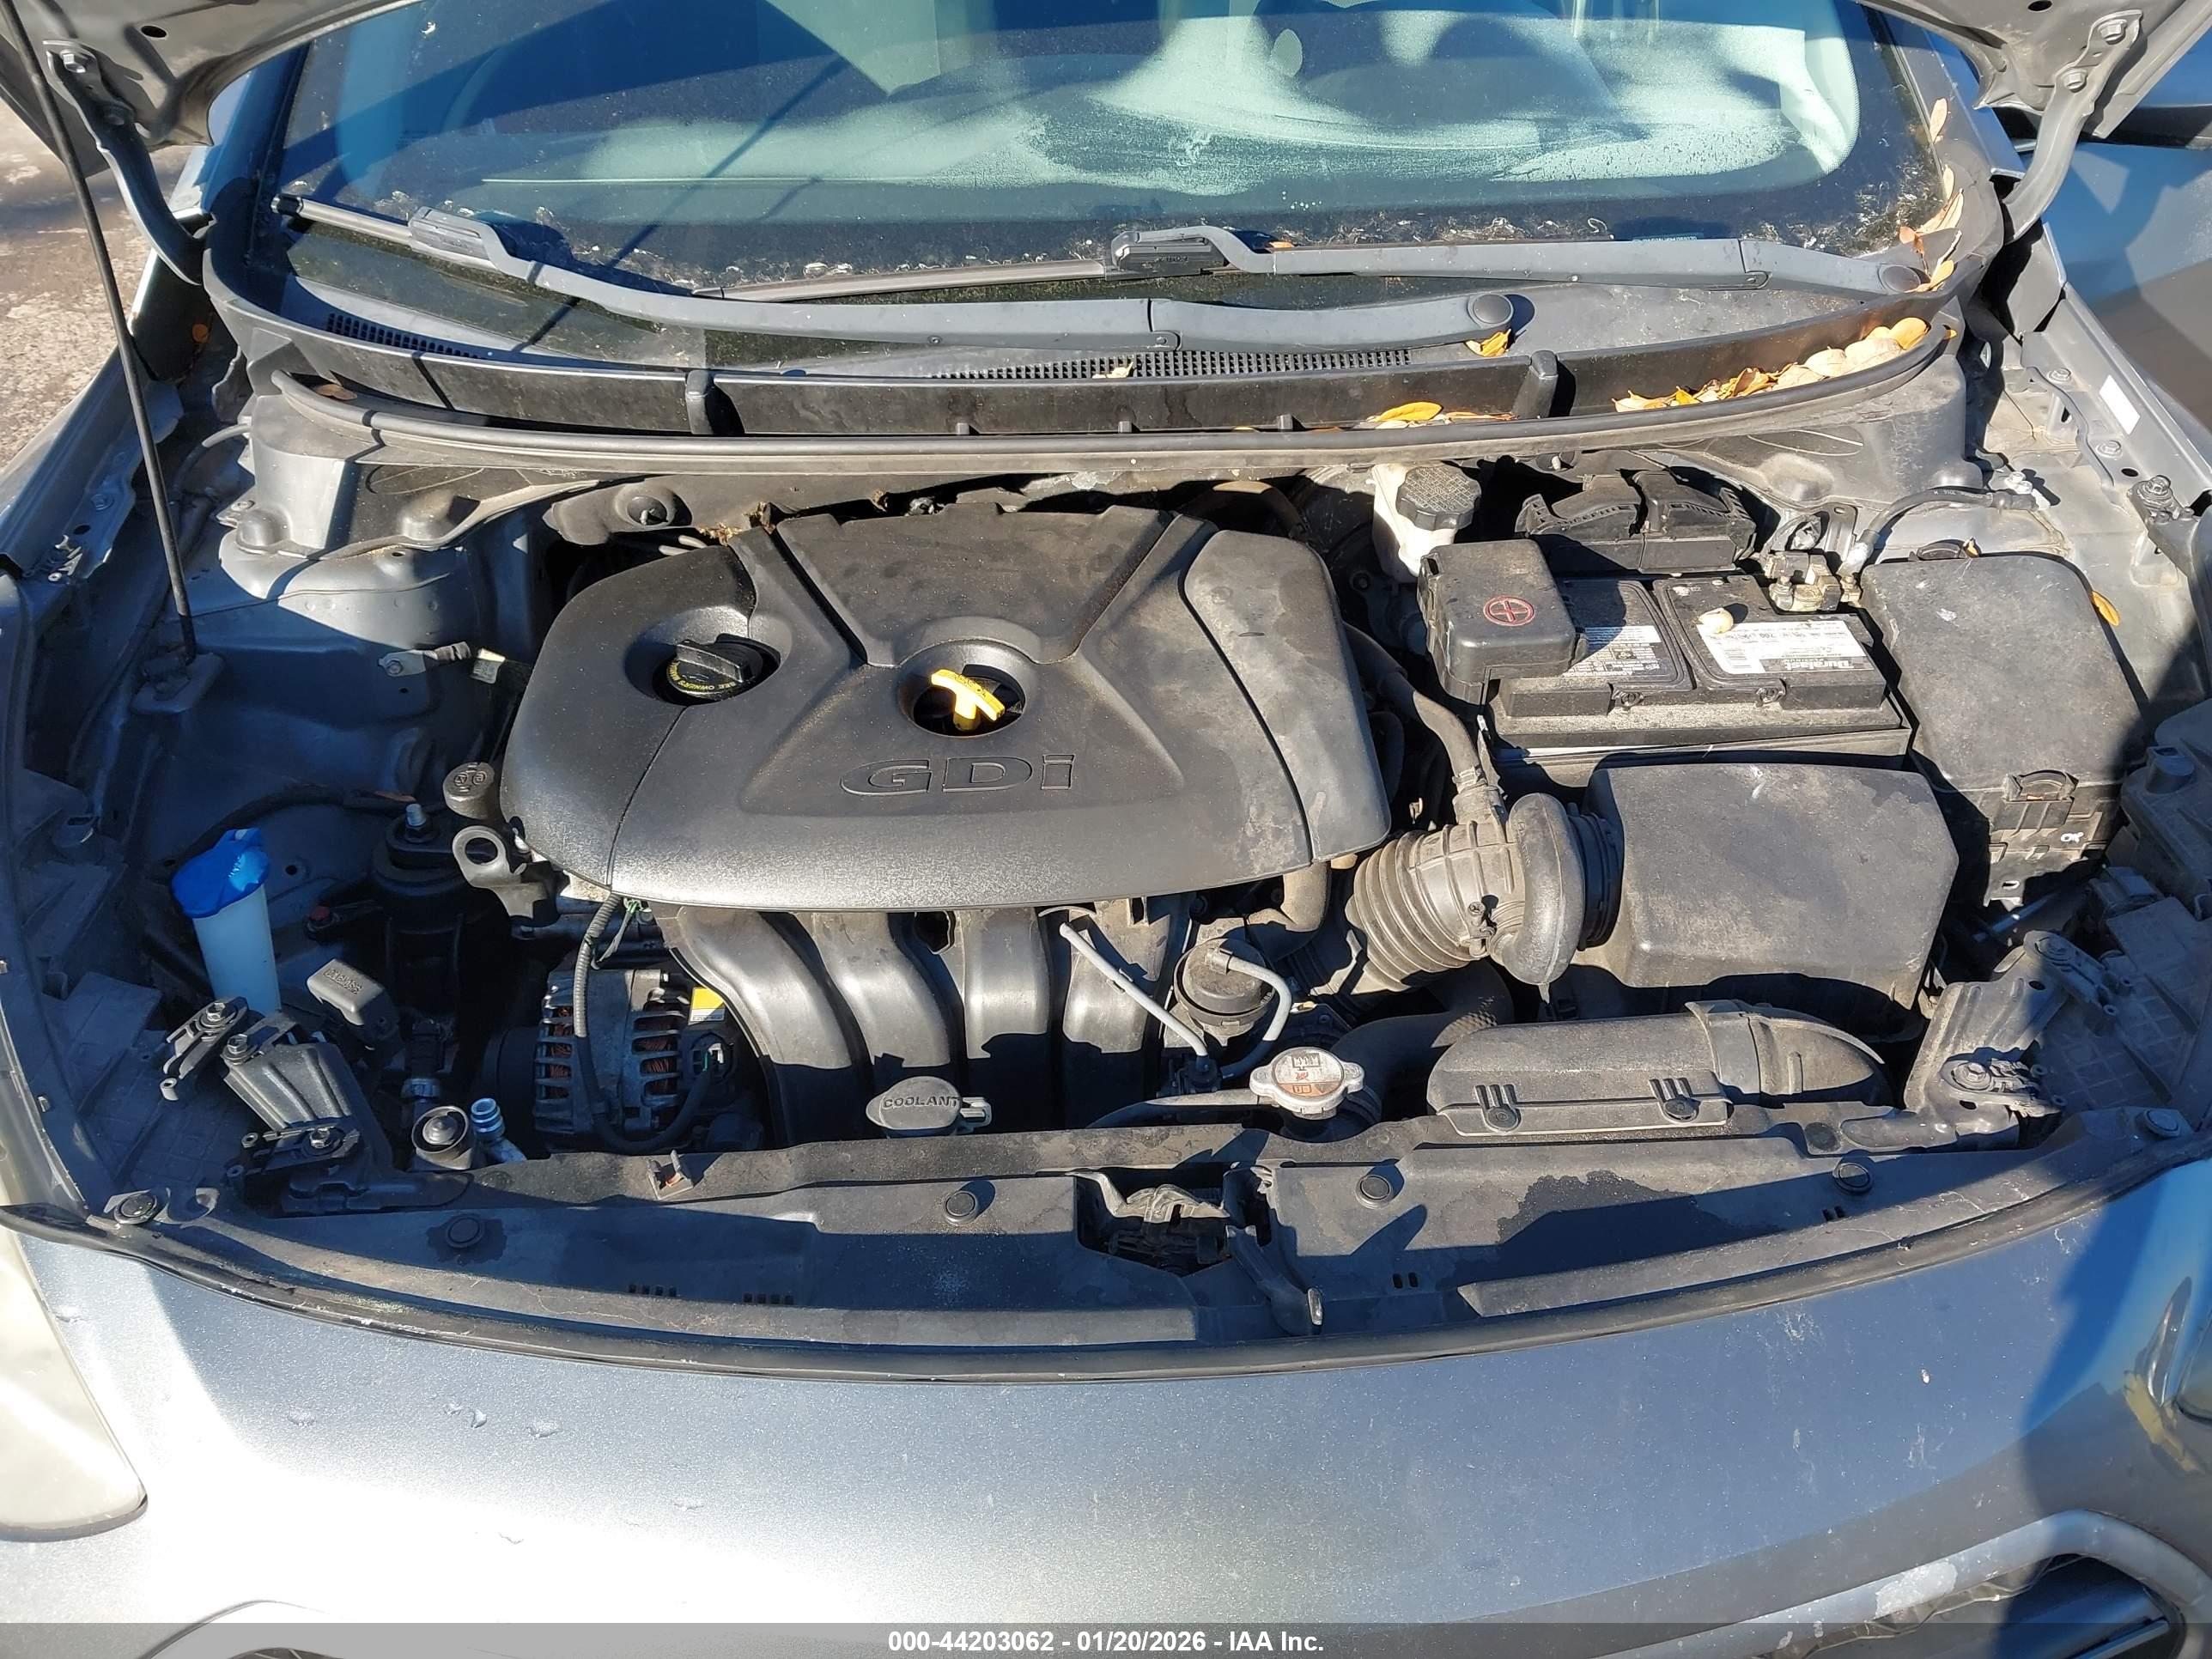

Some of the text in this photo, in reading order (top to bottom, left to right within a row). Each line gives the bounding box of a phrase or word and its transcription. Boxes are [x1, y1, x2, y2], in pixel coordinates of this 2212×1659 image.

[1784, 660, 1855, 672] Duralast
[719, 681, 736, 690] SEE
[883, 1096, 960, 1109] COOLANT
